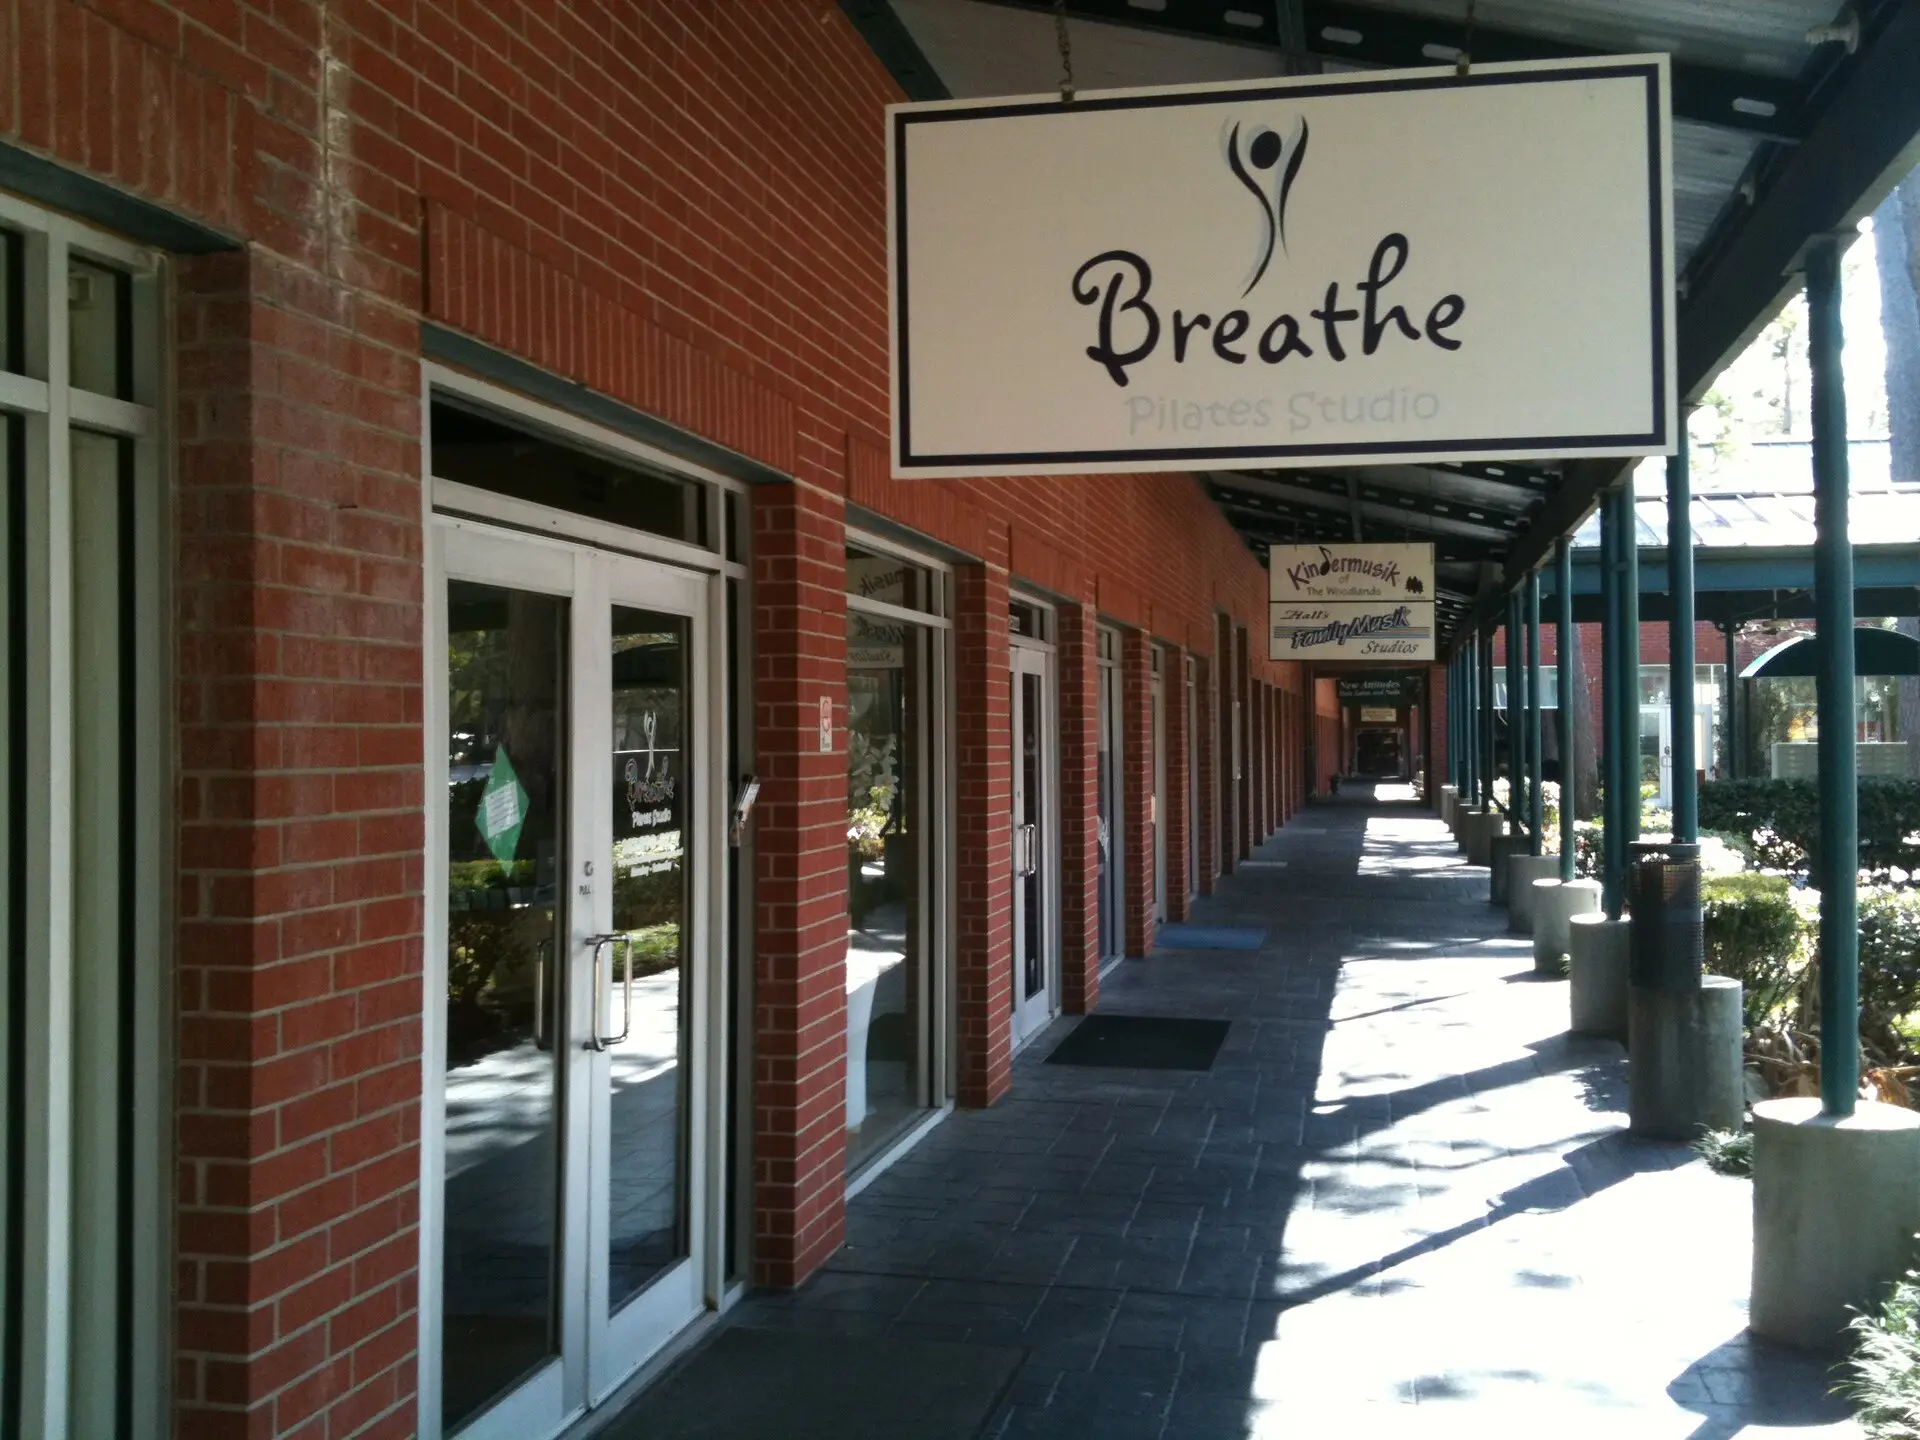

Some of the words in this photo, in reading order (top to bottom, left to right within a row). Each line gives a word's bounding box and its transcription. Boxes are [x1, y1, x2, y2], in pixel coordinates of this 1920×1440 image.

[1071, 232, 1466, 388] Breathe
[1126, 394, 1273, 436] Pilates
[1287, 388, 1440, 434] Studio
[1287, 546, 1400, 590] Kindermusik
[1306, 586, 1324, 597] The
[1325, 585, 1382, 597] Woodlands
[1280, 609, 1330, 620] Hall's
[1360, 639, 1420, 654] Studios
